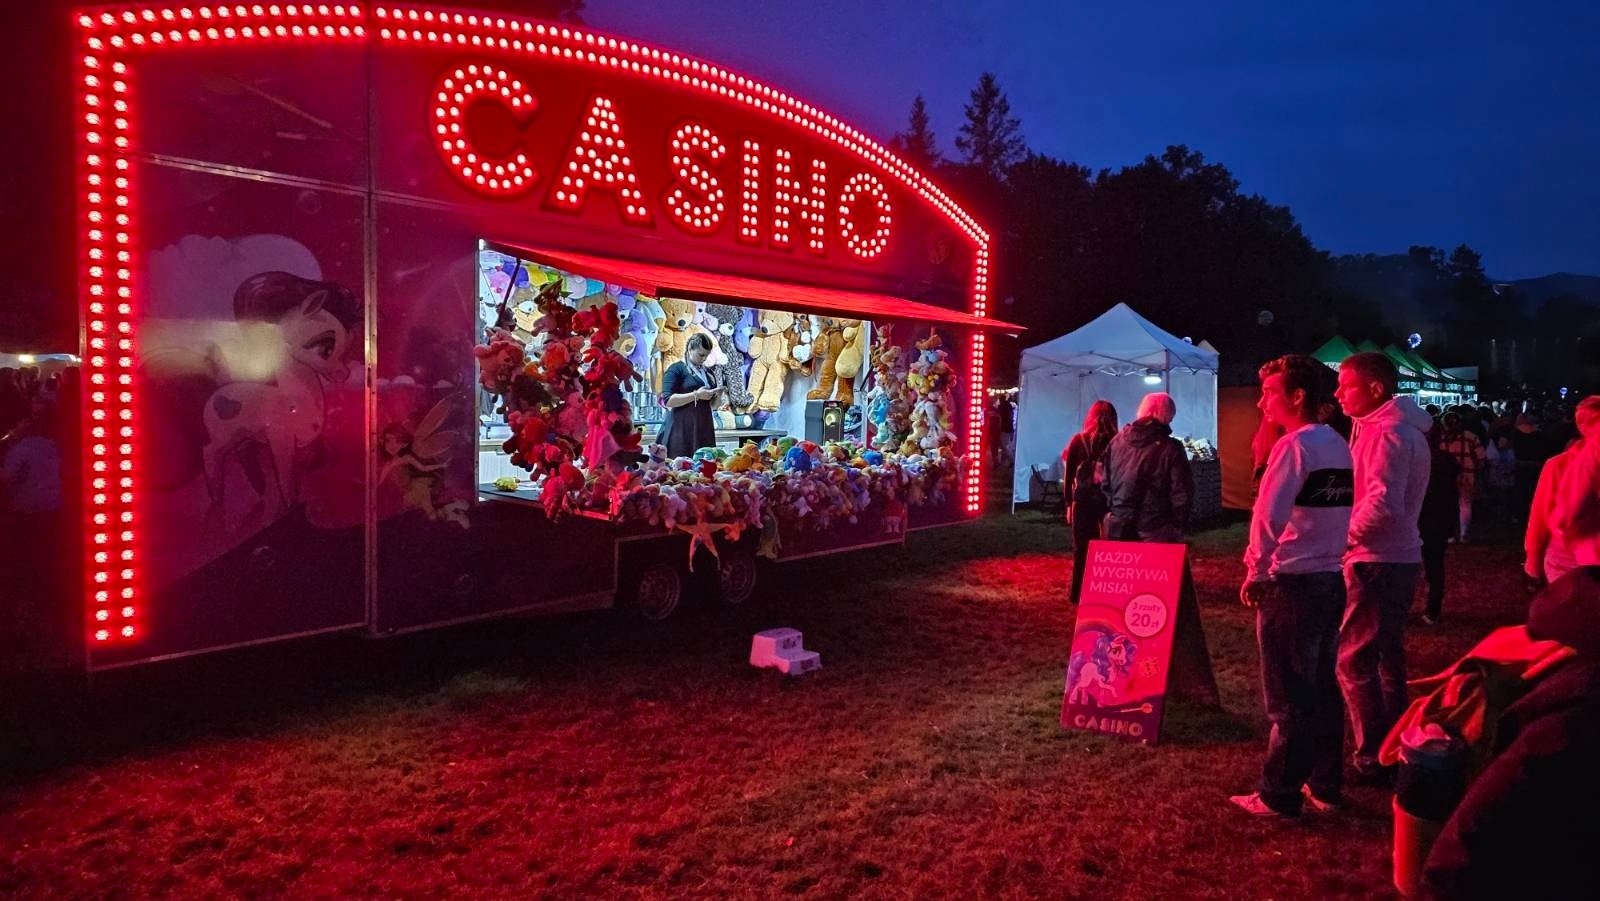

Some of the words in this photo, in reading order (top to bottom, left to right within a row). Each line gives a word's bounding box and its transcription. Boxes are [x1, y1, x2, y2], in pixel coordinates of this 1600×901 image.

[431, 61, 894, 259] CASINO
[1094, 550, 1143, 564] KAŻDY
[1092, 566, 1169, 582] WYGRYWA
[1089, 581, 1134, 595] MISIA!
[1131, 613, 1151, 627] 20
[1074, 714, 1143, 737] CASINO
